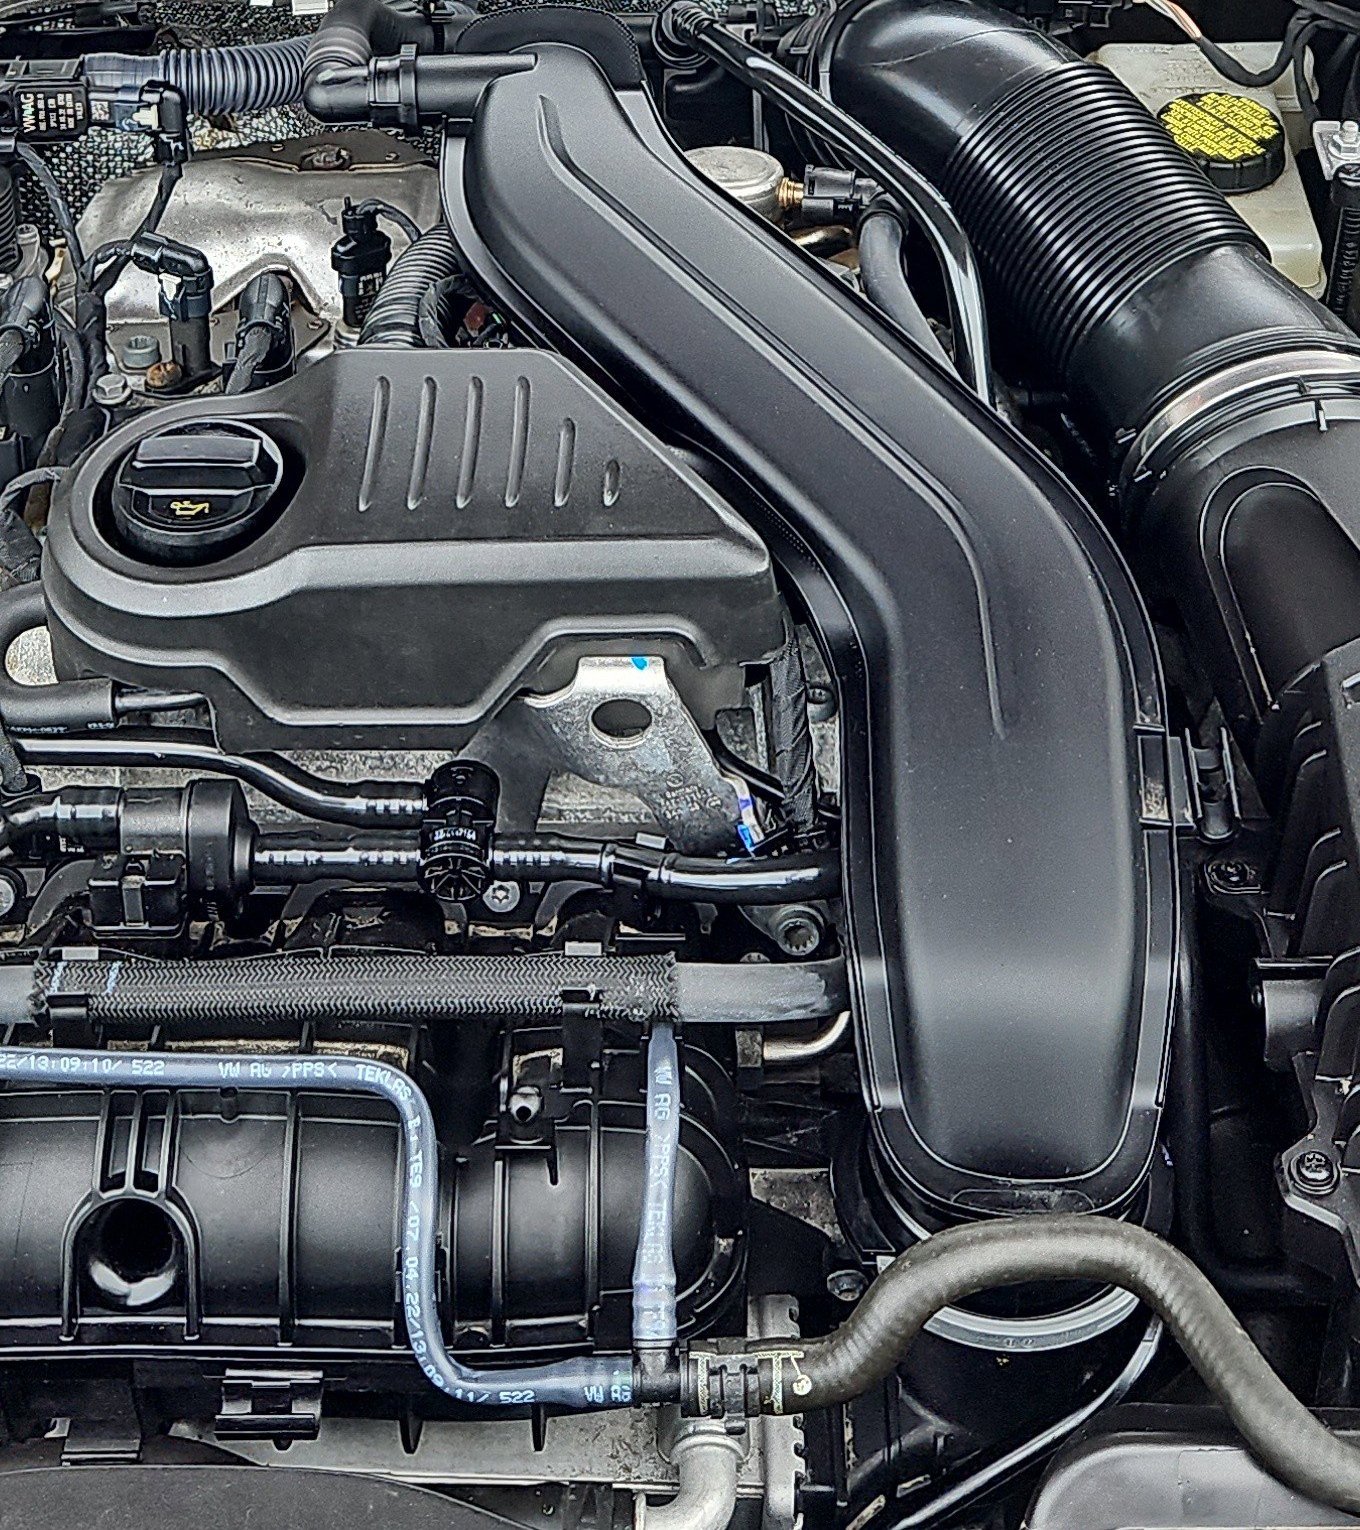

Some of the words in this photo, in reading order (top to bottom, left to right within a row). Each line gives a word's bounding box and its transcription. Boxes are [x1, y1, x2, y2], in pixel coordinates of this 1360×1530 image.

[653, 1092, 672, 1121] AG
[131, 1059, 166, 1077] 522
[218, 1061, 242, 1078] VW
[355, 1063, 414, 1102] TEKLAS
[408, 1149, 423, 1189] TE9
[498, 1389, 536, 1404] 522
[584, 1385, 605, 1404] VW
